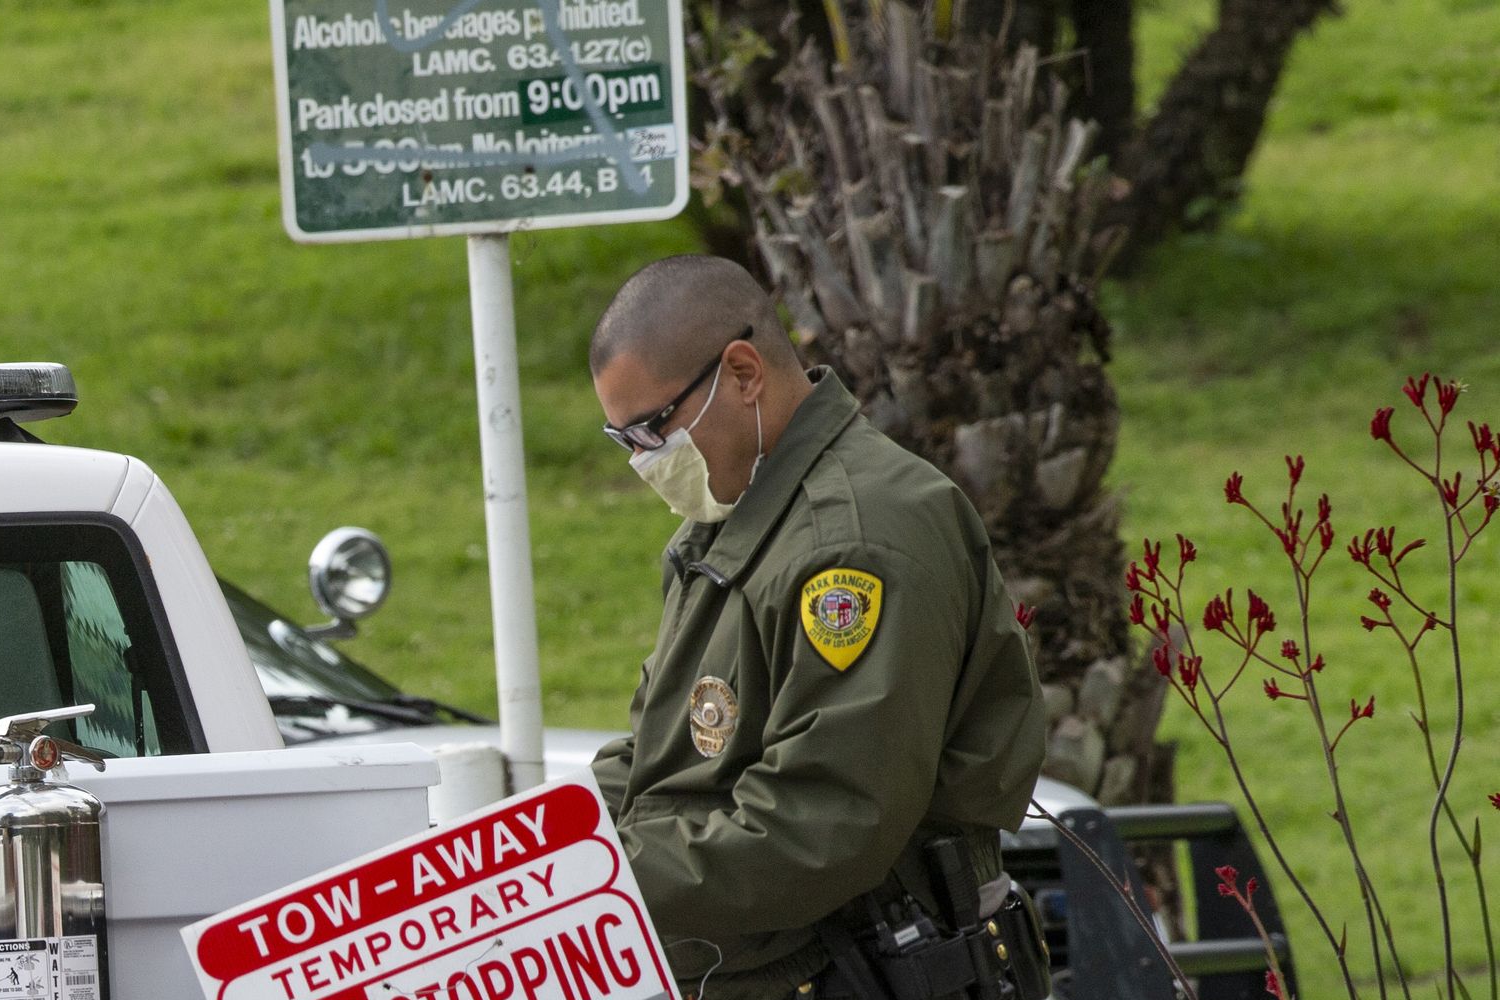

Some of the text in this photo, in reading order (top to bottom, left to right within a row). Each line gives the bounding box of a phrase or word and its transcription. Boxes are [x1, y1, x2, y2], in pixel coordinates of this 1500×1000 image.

[293, 12, 400, 50] Alcoholc
[523, 0, 646, 40] prhibited.
[413, 47, 496, 76] LAMC.
[299, 73, 660, 131] Park closed from 9:00pm
[402, 176, 494, 207] LAMC.
[501, 170, 593, 200] 63.44,
[597, 167, 618, 193] B
[804, 574, 876, 597] PARK RANGER
[833, 638, 845, 647] LOS
[846, 626, 872, 646] ANGELES
